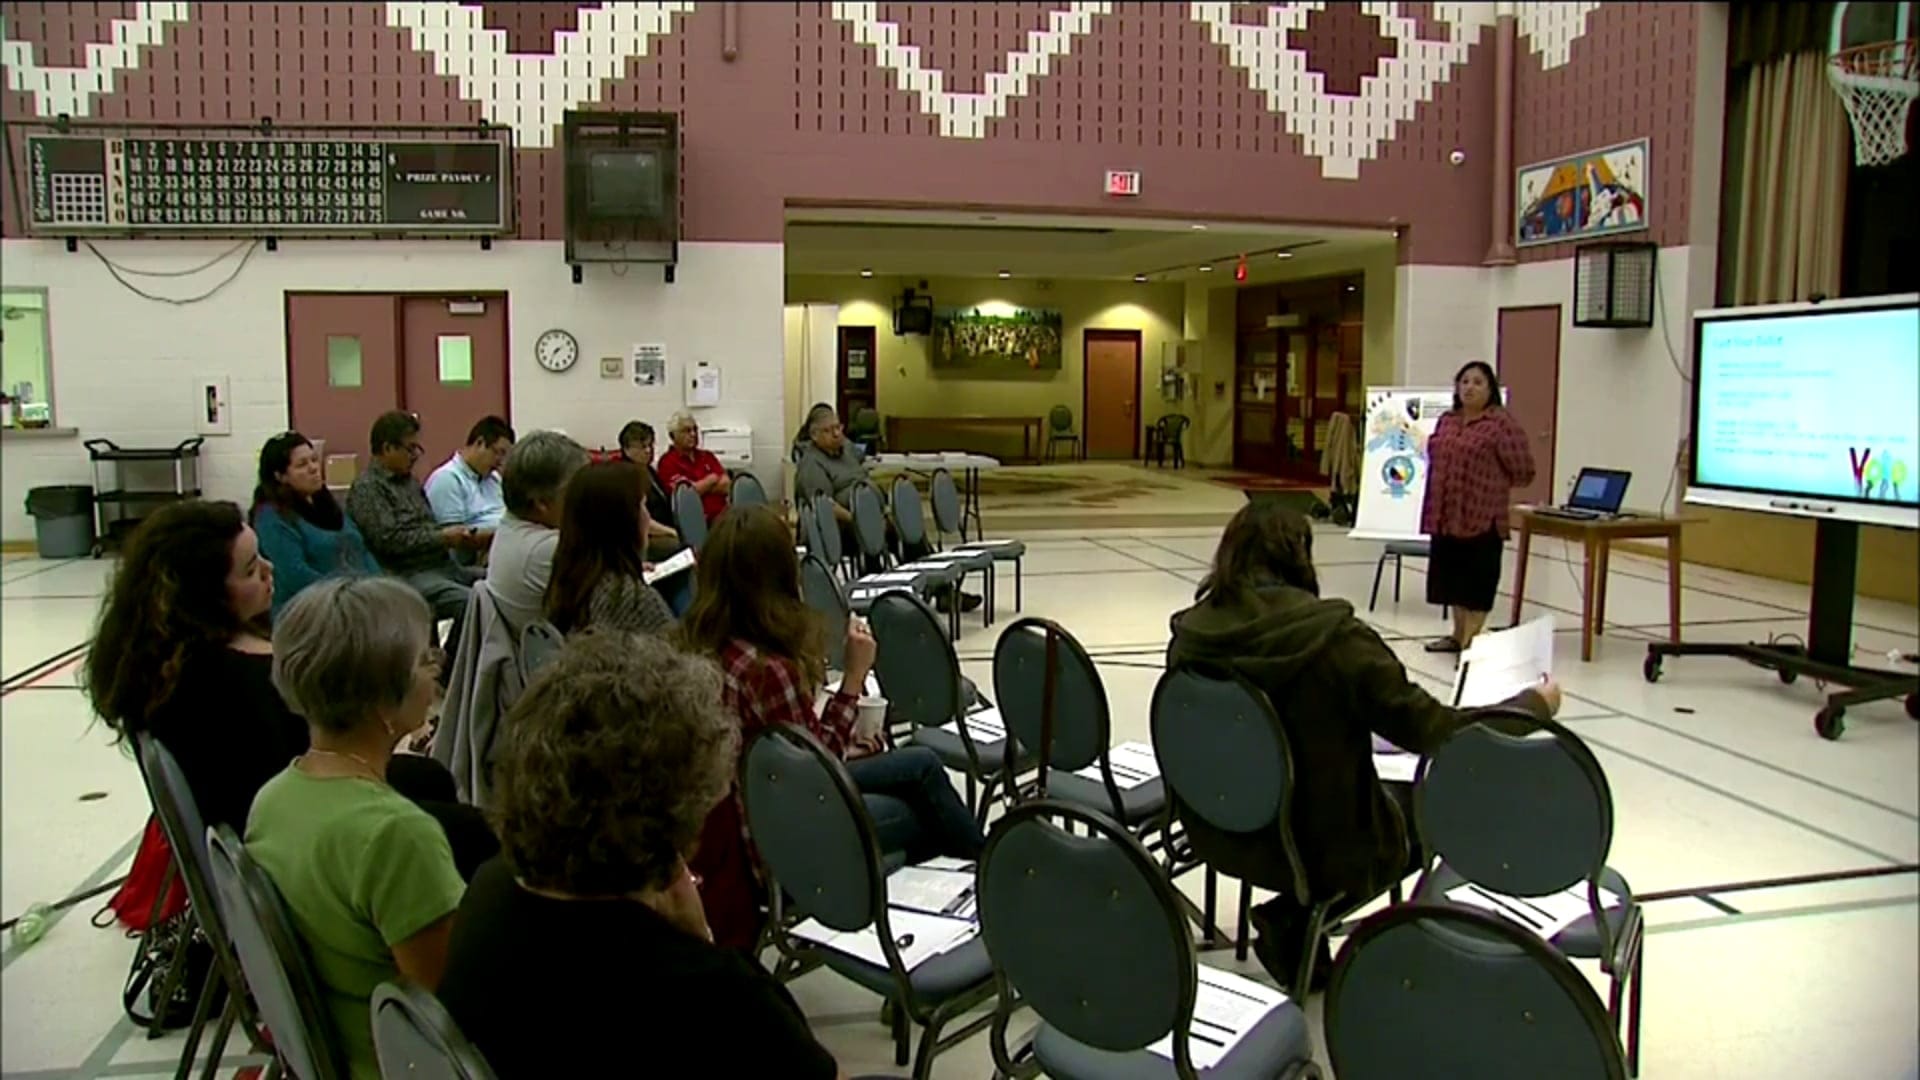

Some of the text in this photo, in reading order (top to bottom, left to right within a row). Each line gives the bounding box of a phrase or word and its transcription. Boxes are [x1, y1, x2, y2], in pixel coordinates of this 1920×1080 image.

[301, 144, 312, 156] 11
[317, 144, 328, 156] 12
[335, 144, 346, 156] 13
[351, 144, 362, 156] 14
[369, 143, 380, 156] 15
[147, 158, 158, 172] 17
[216, 159, 228, 172] 21
[233, 159, 246, 172] 22
[249, 160, 262, 172] 23
[265, 160, 278, 172] 24
[282, 160, 296, 172] 25
[317, 160, 330, 173] 27
[129, 175, 142, 188] 31
[147, 176, 160, 188] 32
[165, 176, 178, 188] 33
[181, 176, 194, 189] 34
[199, 176, 212, 189] 35
[233, 176, 246, 188] 37
[301, 176, 312, 188] 41
[317, 177, 330, 190] 42
[334, 176, 347, 190] 43
[351, 177, 364, 189] 44
[368, 176, 380, 190] 45
[1111, 173, 1135, 192] EXIT
[148, 192, 161, 204] 47
[217, 192, 230, 205] 51
[234, 192, 246, 206] 52
[249, 192, 263, 206] 53
[266, 192, 280, 205] 54
[283, 192, 296, 206] 55
[317, 193, 330, 206] 57
[148, 208, 162, 222] 62
[165, 208, 180, 221] 63
[183, 209, 196, 222] 64
[200, 209, 214, 221] 65
[234, 208, 248, 222] 67
[303, 209, 314, 221] 71
[318, 210, 330, 222] 72
[335, 210, 348, 222] 73
[352, 210, 364, 221] 74
[369, 210, 381, 222] 75
